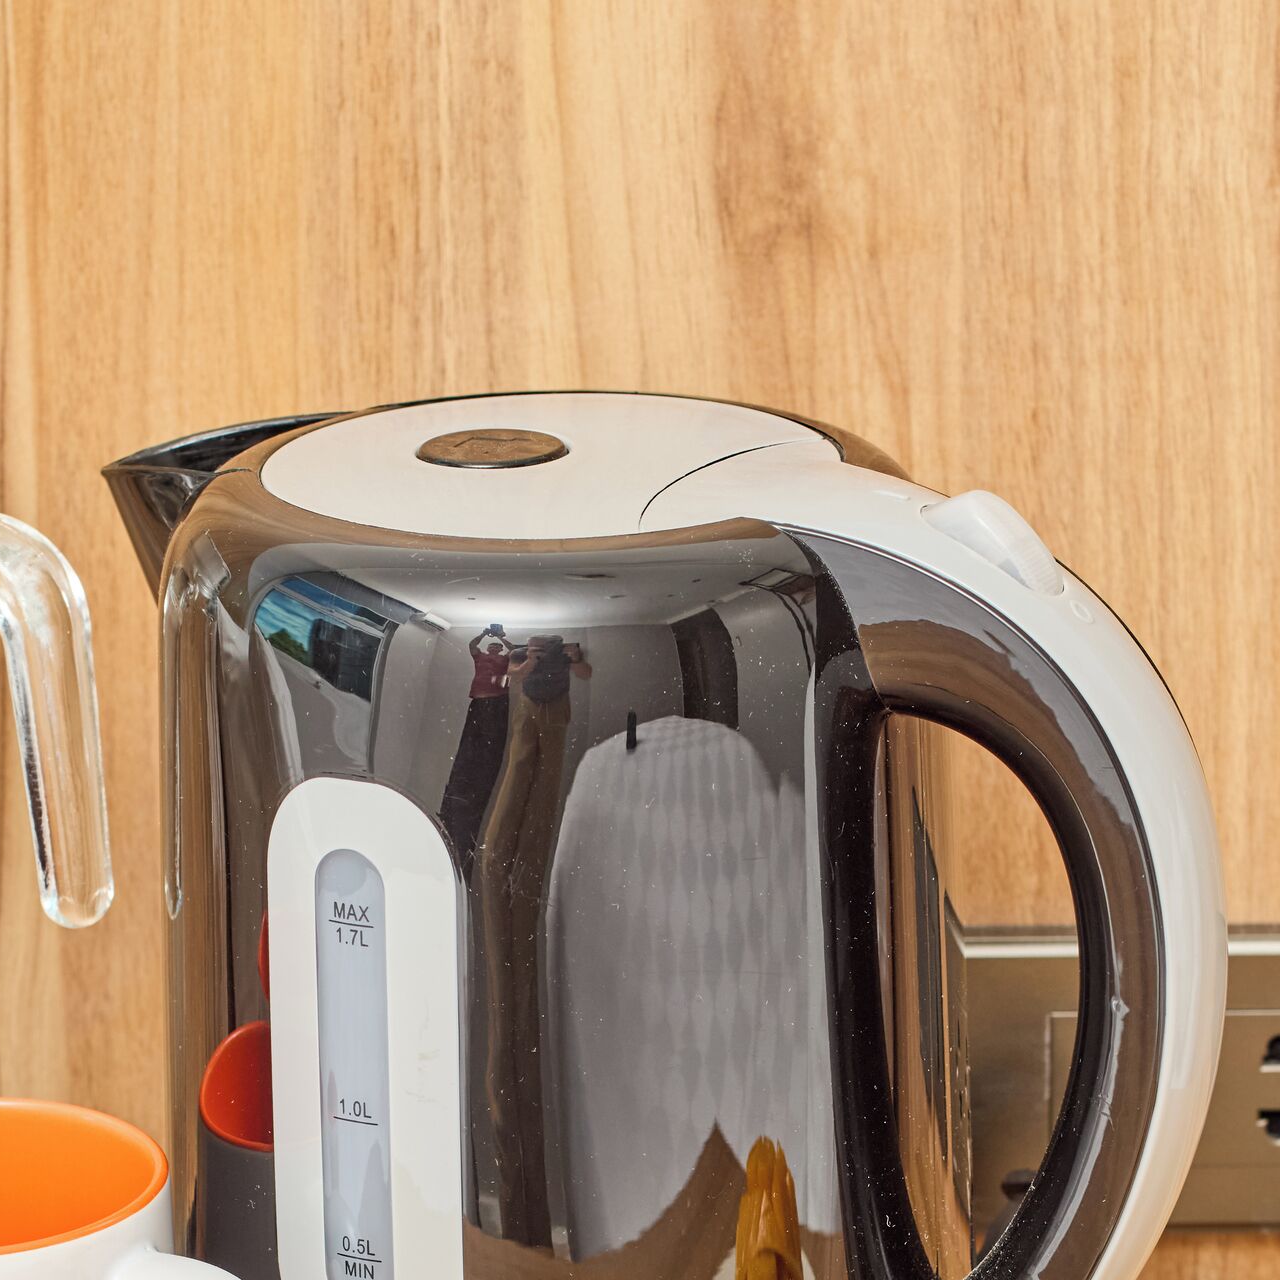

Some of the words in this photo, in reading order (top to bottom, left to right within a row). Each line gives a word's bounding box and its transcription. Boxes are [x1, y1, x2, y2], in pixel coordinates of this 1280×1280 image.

[333, 901, 370, 923] MAX
[336, 927, 369, 947] 1.7L
[339, 1098, 372, 1119] 1.0L
[342, 1235, 376, 1256] 0.5L
[344, 1260, 375, 1280] MIN
